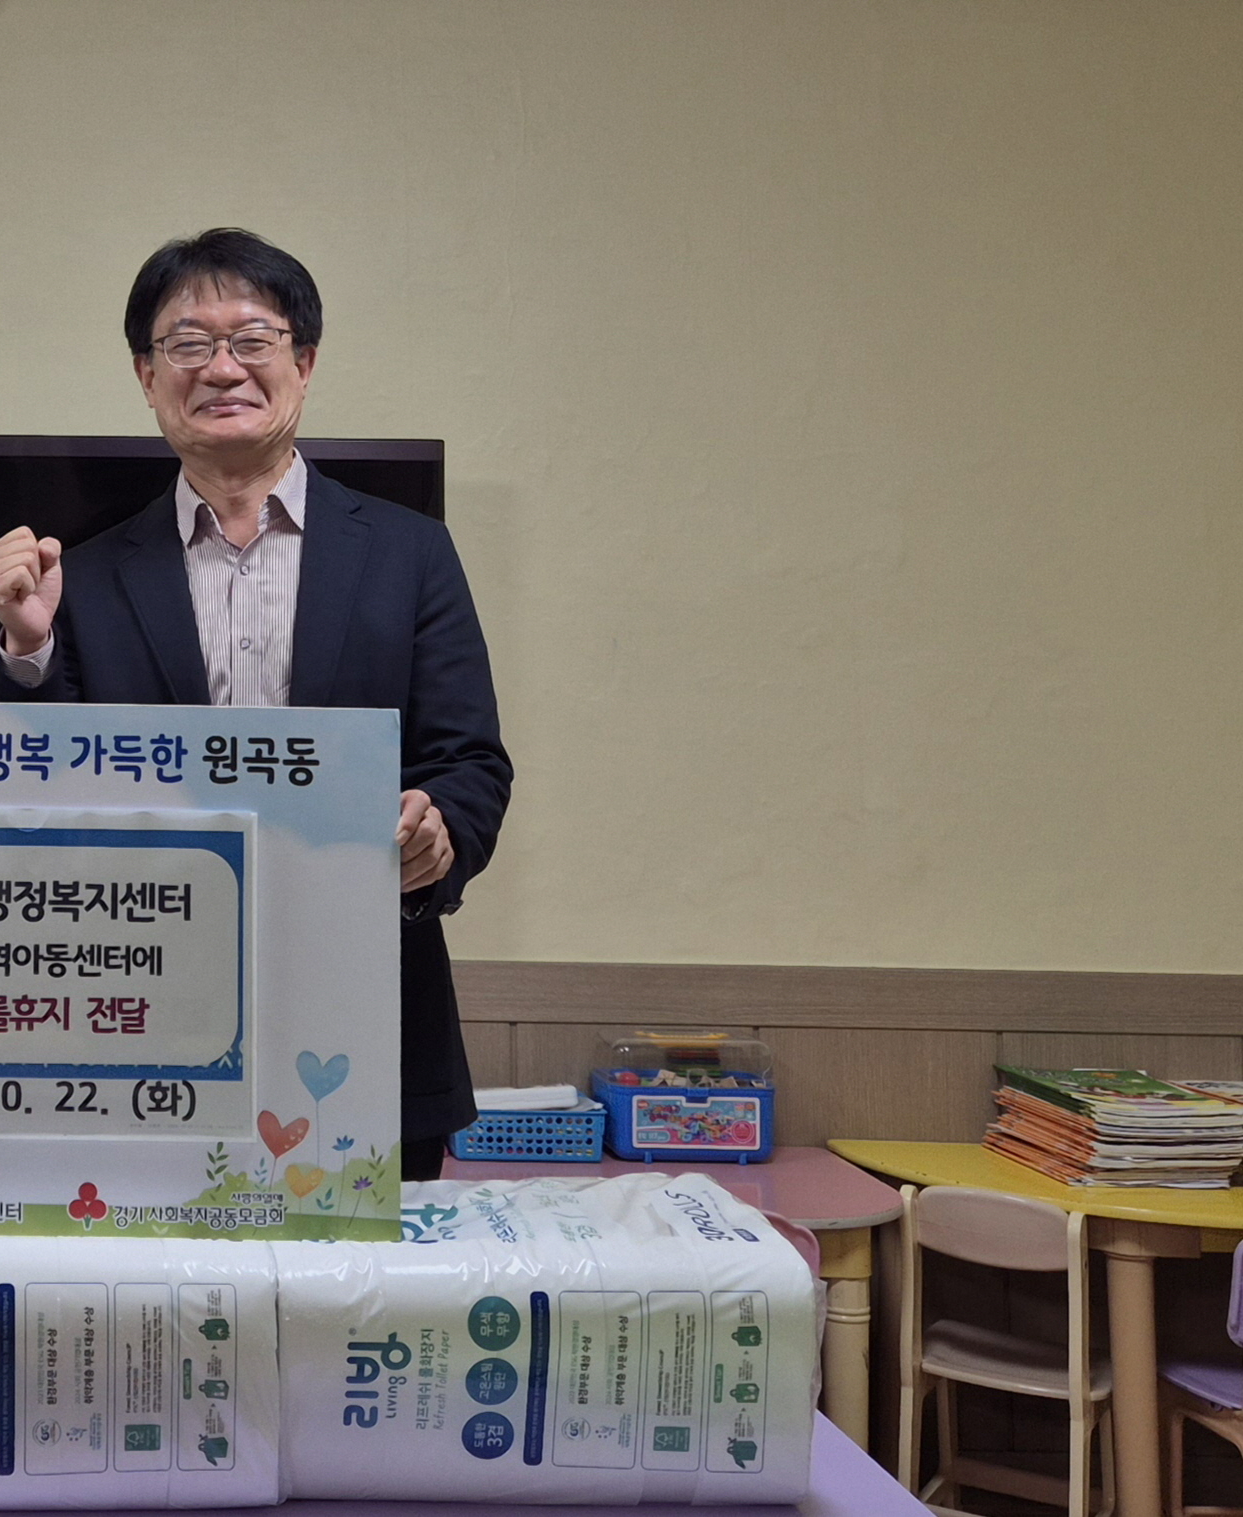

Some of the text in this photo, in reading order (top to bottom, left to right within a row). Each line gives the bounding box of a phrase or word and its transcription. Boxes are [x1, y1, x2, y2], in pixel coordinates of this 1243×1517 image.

[70, 733, 188, 783] 가득한
[202, 736, 320, 786] 원곡동
[87, 997, 149, 1035] 전달
[54, 1081, 110, 1115] 22.
[131, 1080, 196, 1121] (화)
[113, 1206, 286, 1229] 경기 사회복지공동모금회
[480, 1312, 492, 1337] 무색
[496, 1312, 510, 1337] 무향
[618, 1316, 628, 1333] 수상
[83, 1307, 94, 1404] 취약계층 부문 대상 수상
[617, 1335, 627, 1353] 대상
[47, 1329, 57, 1405] 환경부문 대상 수상
[343, 1332, 411, 1428] 리빙
[416, 1329, 434, 1430] 리프레쉬 롤화장지
[434, 1329, 451, 1430] Refresh Toilet Paper
[578, 1336, 591, 1405] 환경부문 대상 수상
[617, 1355, 627, 1371] 부문
[479, 1363, 492, 1399] 고온스팀
[494, 1372, 506, 1390] 원단
[615, 1373, 626, 1405] 취약계층
[474, 1423, 486, 1448] 도톰한
[487, 1425, 504, 1447] 3겹
